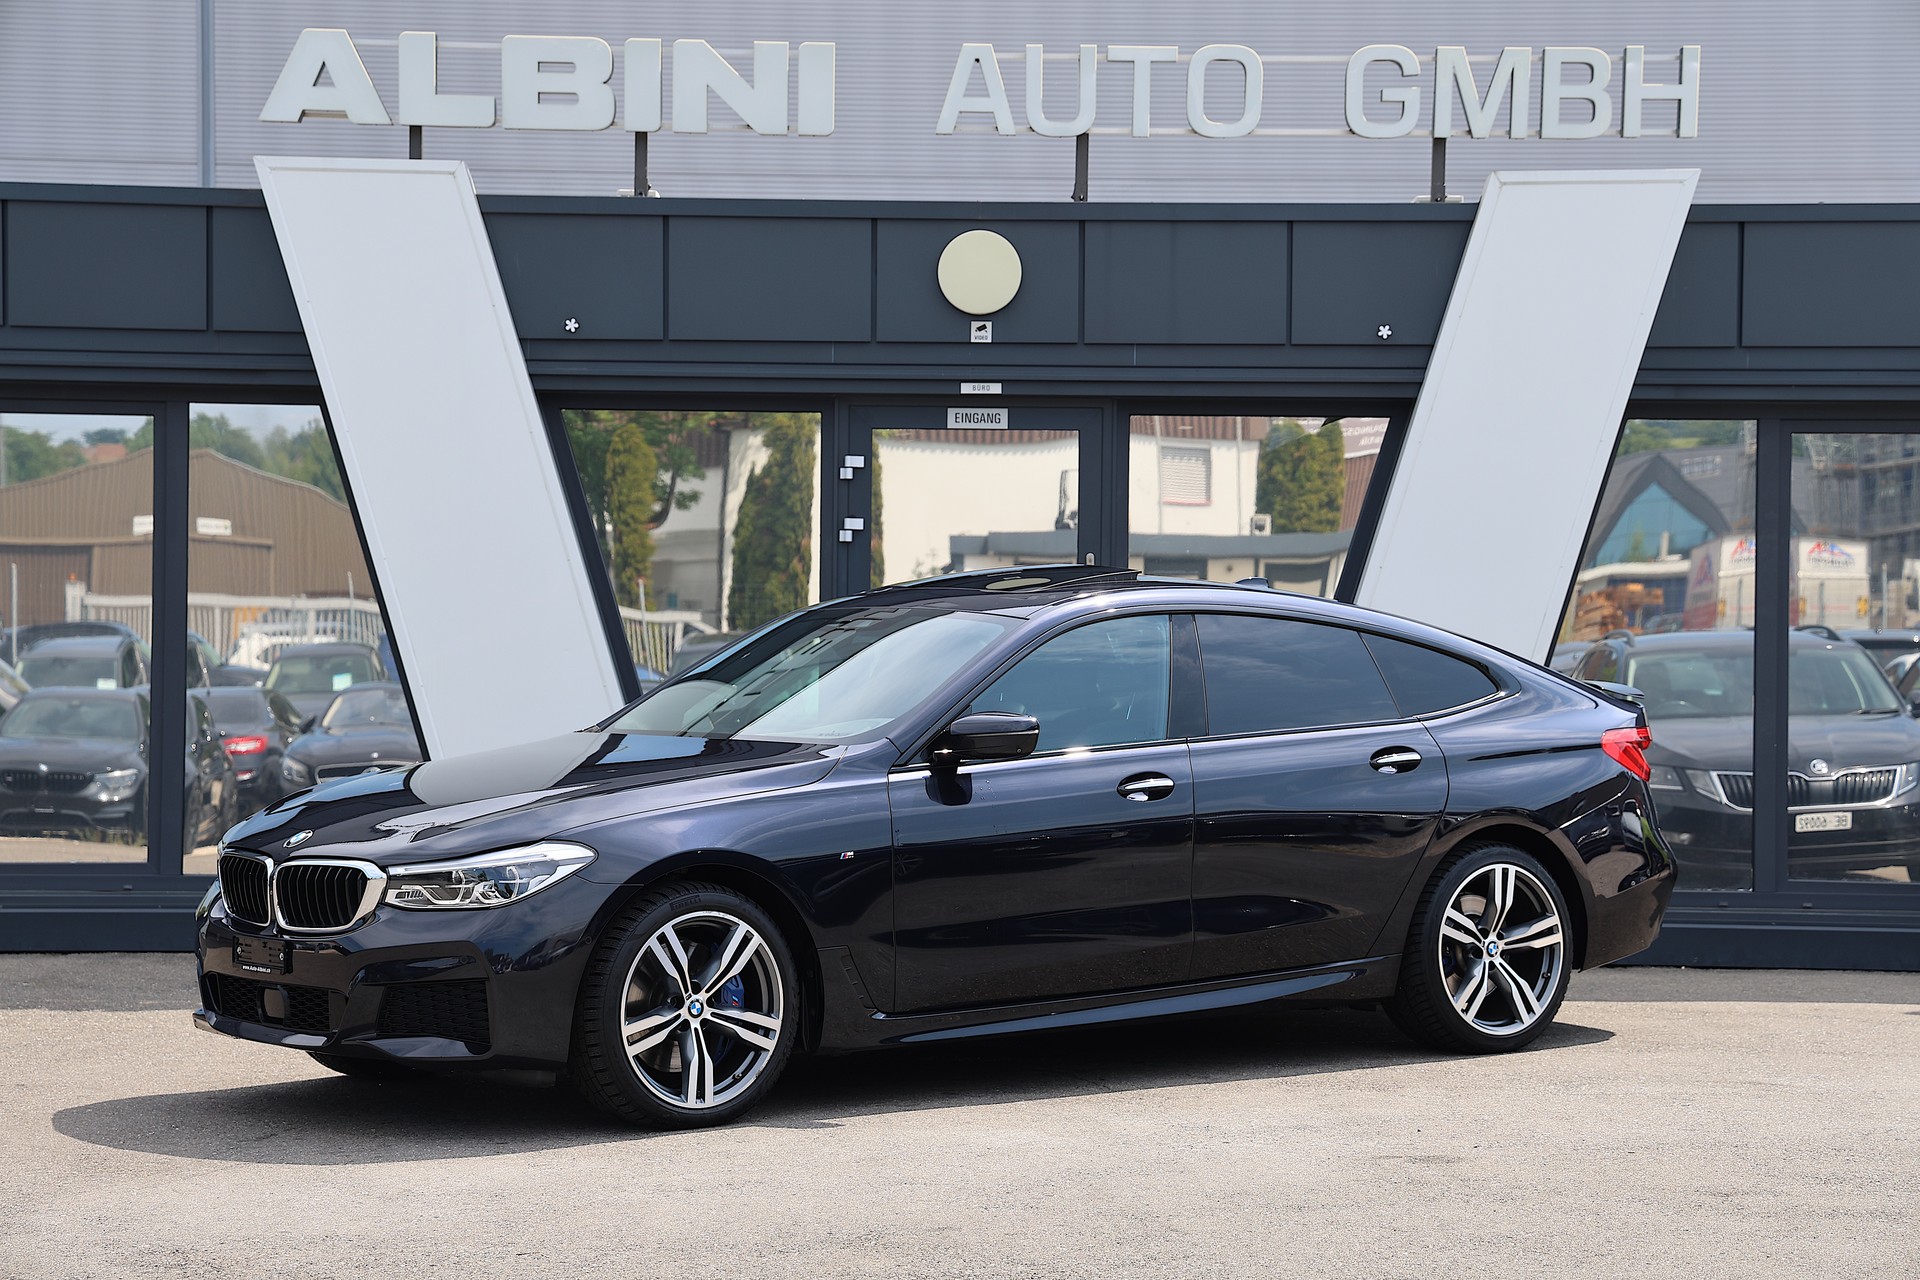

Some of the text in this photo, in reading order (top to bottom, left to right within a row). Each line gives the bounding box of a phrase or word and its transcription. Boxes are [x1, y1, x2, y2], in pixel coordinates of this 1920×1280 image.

[258, 27, 1702, 140] ALBINI AUTO GMBH
[972, 384, 991, 392] BÜRO
[954, 412, 1001, 424] EINGANG
